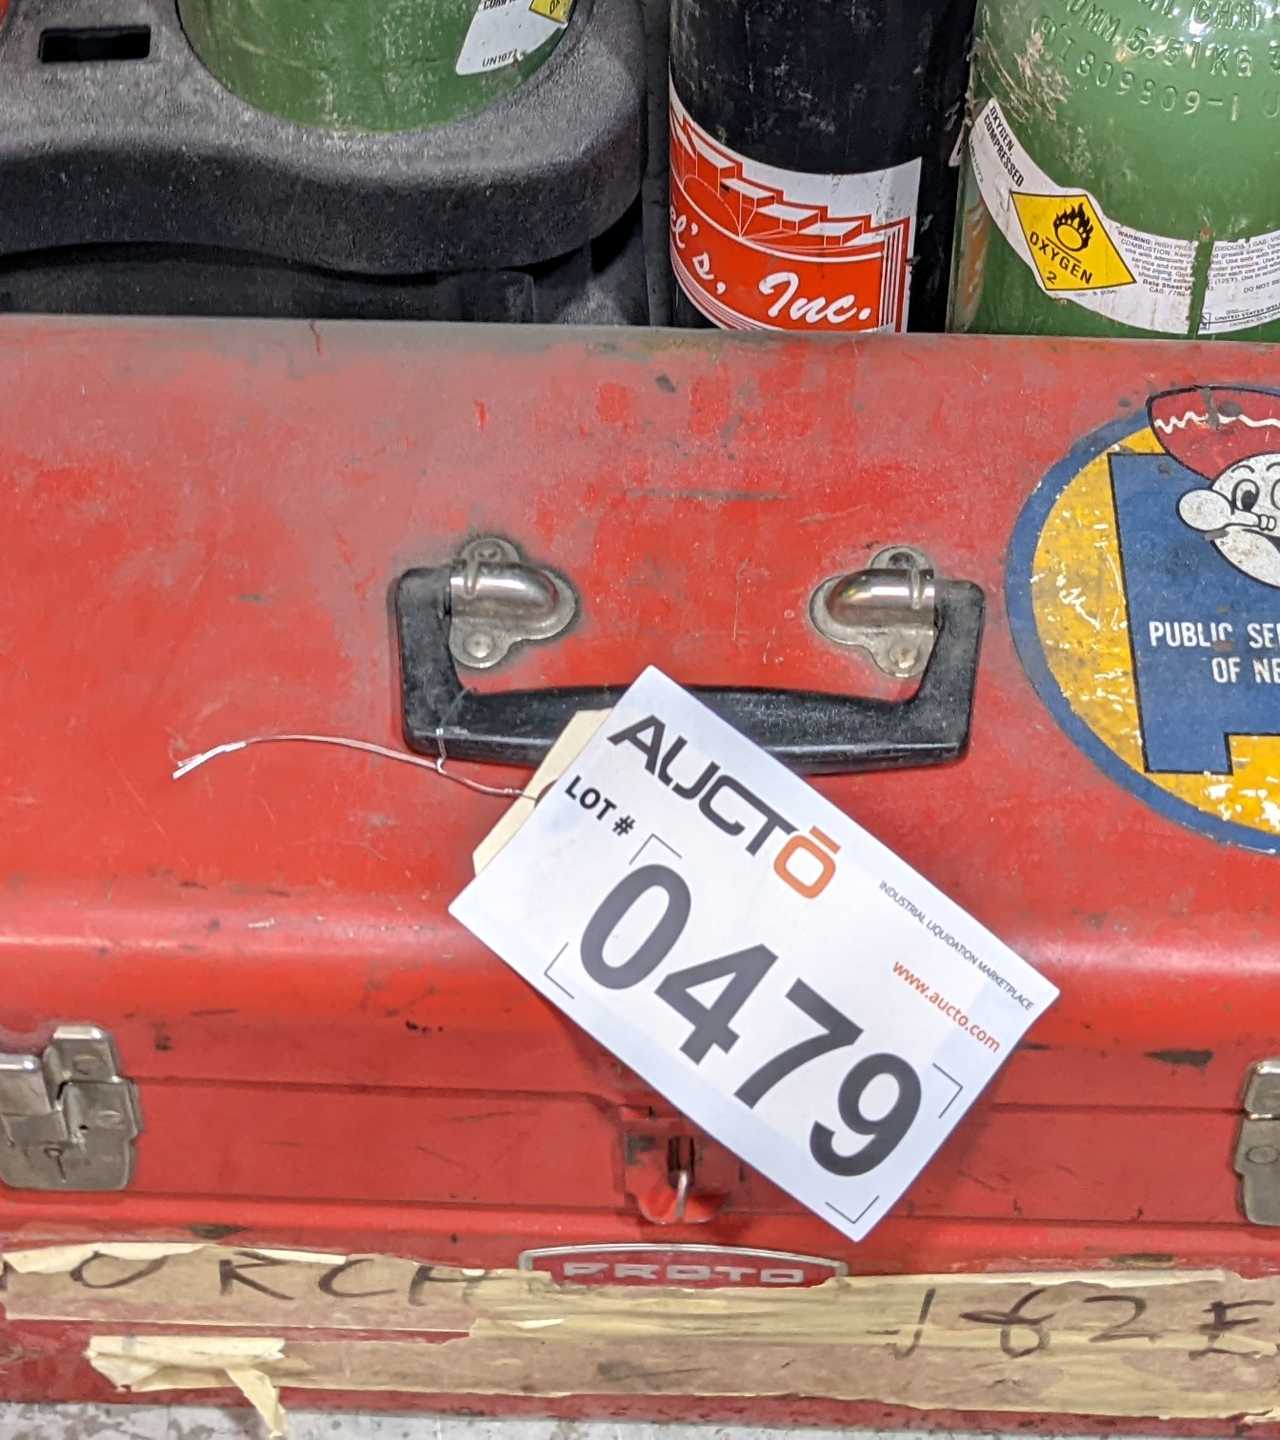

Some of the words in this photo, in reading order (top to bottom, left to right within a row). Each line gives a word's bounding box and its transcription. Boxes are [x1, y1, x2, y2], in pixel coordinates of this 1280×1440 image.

[982, 113, 1025, 188] COMPRESSED
[1028, 230, 1093, 285] OXYGEN
[1046, 270, 1058, 287] 2
[758, 271, 872, 324] Inc.
[1149, 620, 1233, 648] PUBLIC
[1211, 656, 1241, 685] OF
[564, 774, 618, 822] LOT
[611, 814, 637, 837] #
[879, 879, 927, 925] INDUSTRIAL
[926, 919, 979, 966] LIQUIDATION
[976, 959, 1035, 1012] MARKETPLACE
[579, 863, 923, 1178] 0479
[892, 960, 1002, 1054] www.aucto.com
[562, 1262, 805, 1285] PROTO
